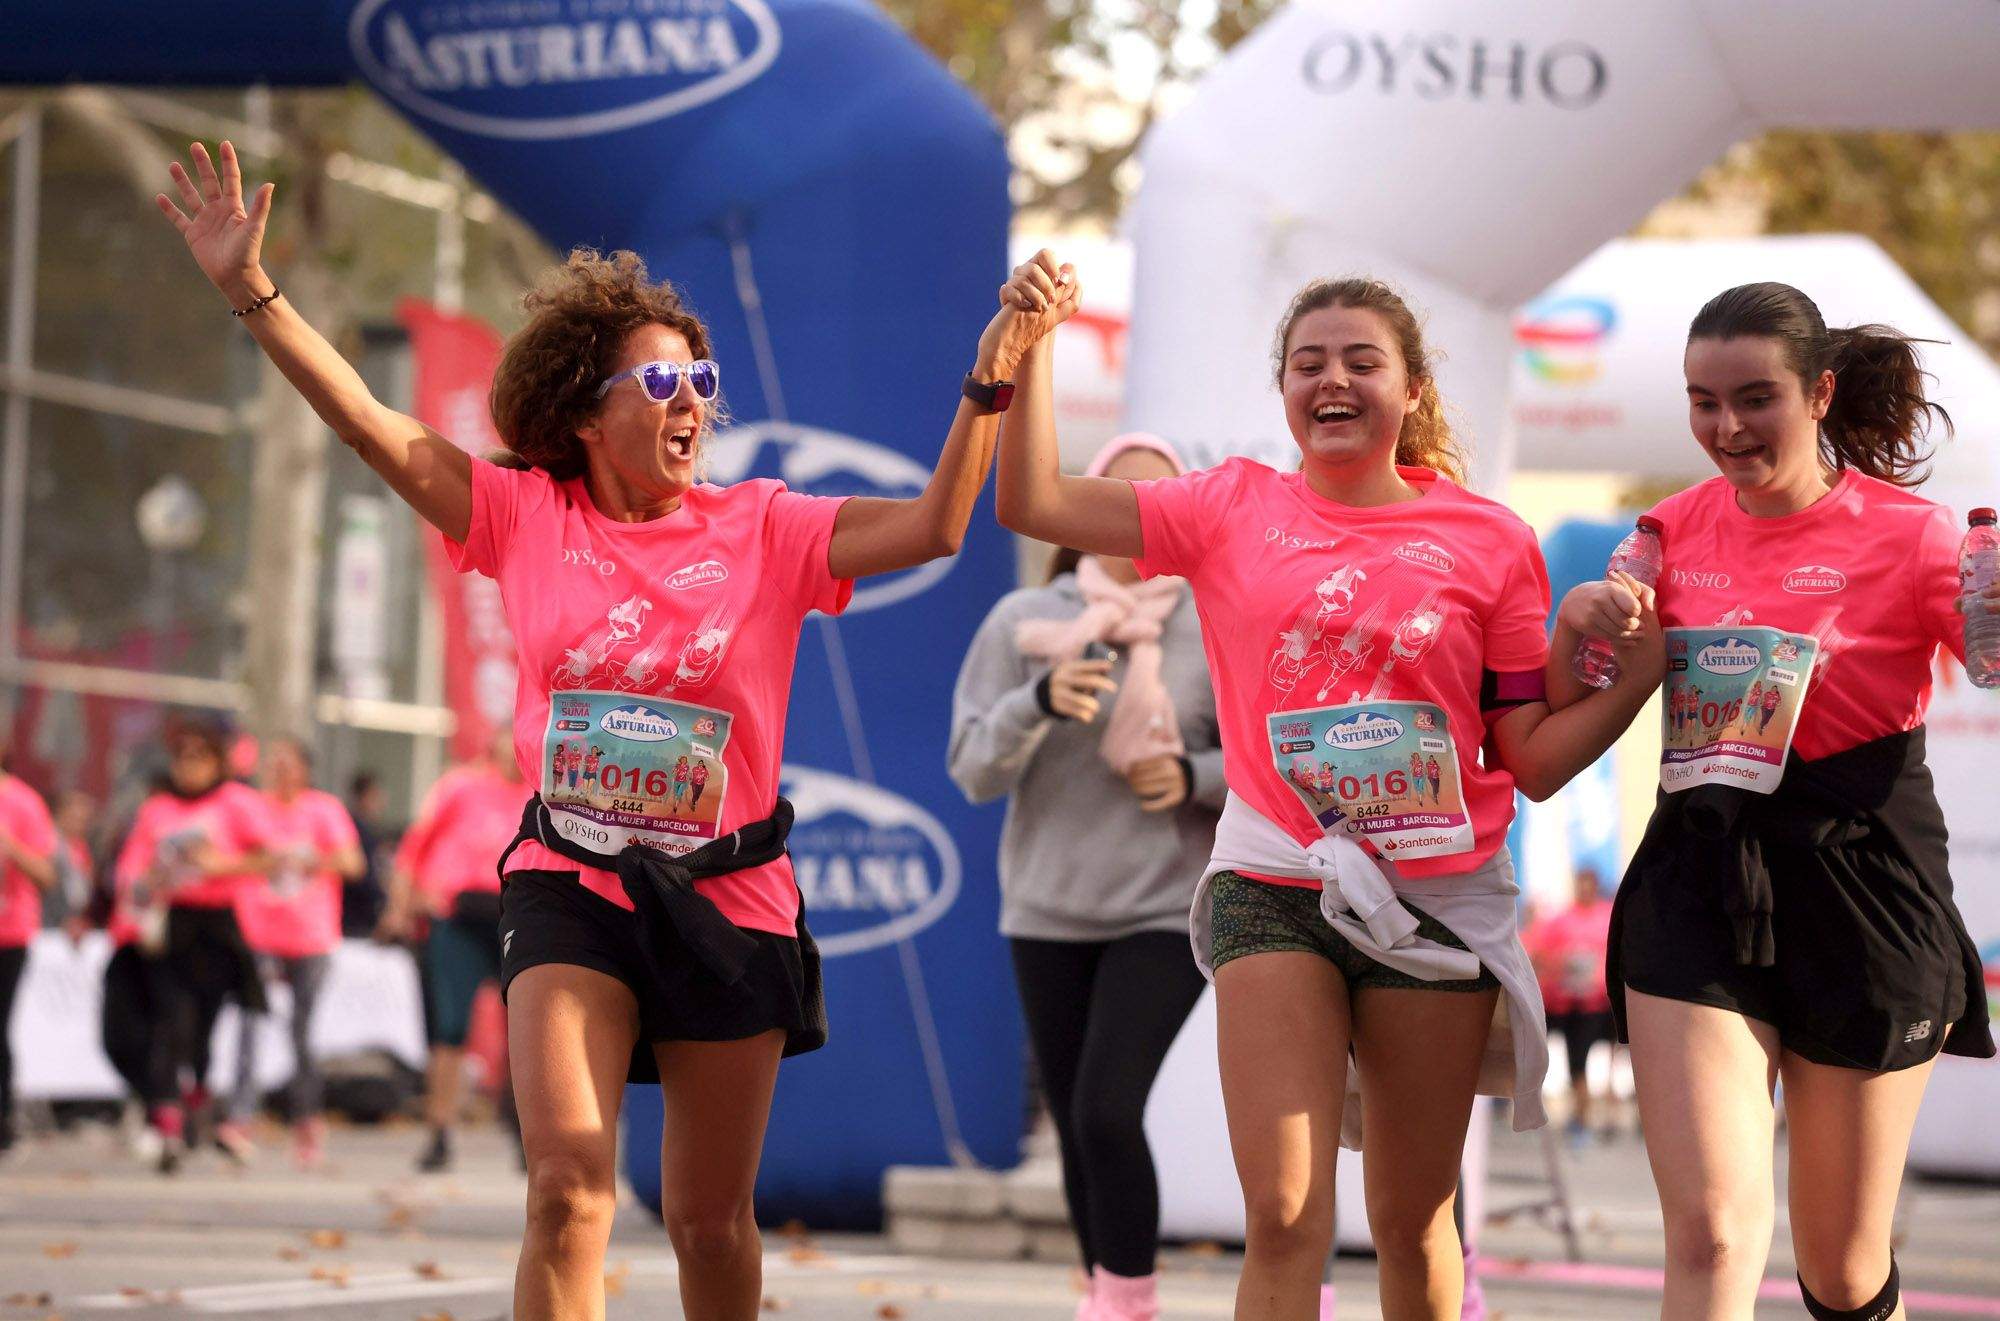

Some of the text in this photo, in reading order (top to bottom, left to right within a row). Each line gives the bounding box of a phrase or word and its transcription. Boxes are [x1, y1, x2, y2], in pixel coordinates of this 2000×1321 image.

[382, 15, 741, 90] ASTURIANA
[1301, 30, 1608, 111] OYSHO
[671, 571, 724, 587] ASTURIANA
[1786, 576, 1841, 589] ASTURIANA
[1701, 651, 1757, 666] ASTURIANA
[562, 707, 590, 717] SUMA
[1417, 713, 1432, 725] 20
[604, 715, 673, 736] ASTURIANA
[1281, 728, 1312, 738] SUMA
[1330, 727, 1400, 744] ASTURIANA
[1721, 743, 1767, 759] BARCELONA
[1710, 763, 1760, 780] Santander
[601, 763, 668, 797] 016
[1338, 769, 1408, 801] 016
[612, 799, 644, 814] 8444
[1356, 804, 1390, 819] 8442
[563, 803, 700, 833] CARRERA DE LA MUJER BARCELONA
[1367, 819, 1396, 830] MUJER
[1403, 815, 1450, 827] BARCELONA
[564, 819, 609, 844] OYSHO
[1398, 835, 1453, 850] Santander
